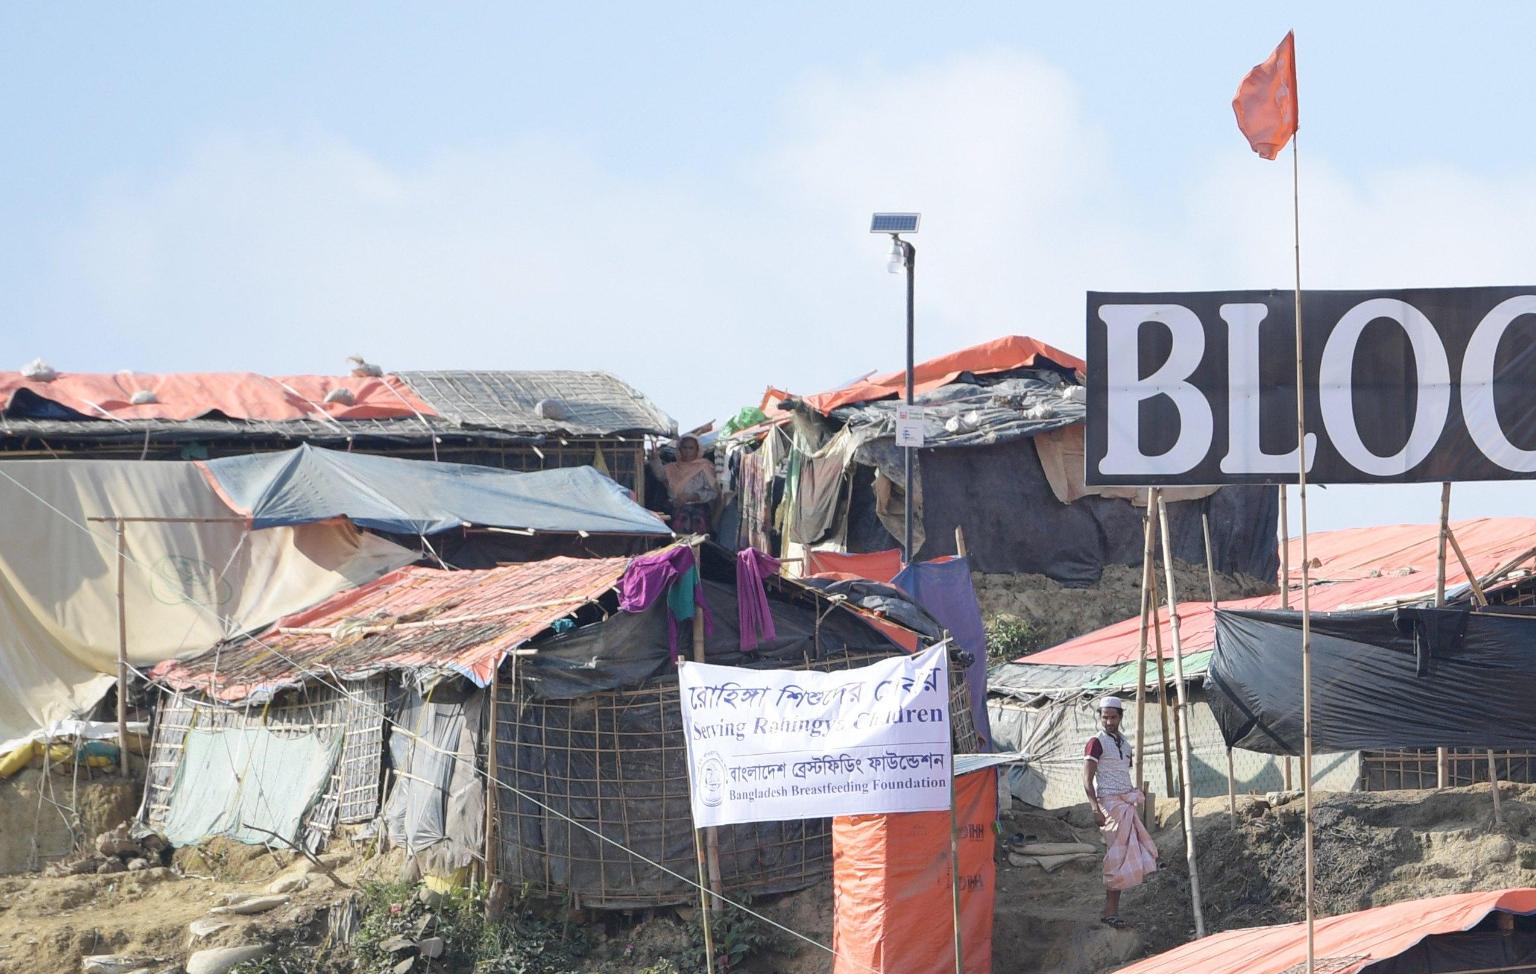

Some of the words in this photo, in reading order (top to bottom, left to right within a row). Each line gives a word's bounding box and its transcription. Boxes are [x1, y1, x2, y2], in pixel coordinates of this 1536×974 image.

[693, 718, 747, 742] Serving
[753, 716, 845, 738] Rhingy
[853, 704, 943, 729] Chldren
[728, 762, 787, 783] বাংলাদেশ
[730, 786, 788, 801] Bangladesh
[791, 780, 869, 797] Breastfeeding
[873, 776, 947, 790] Foundation
